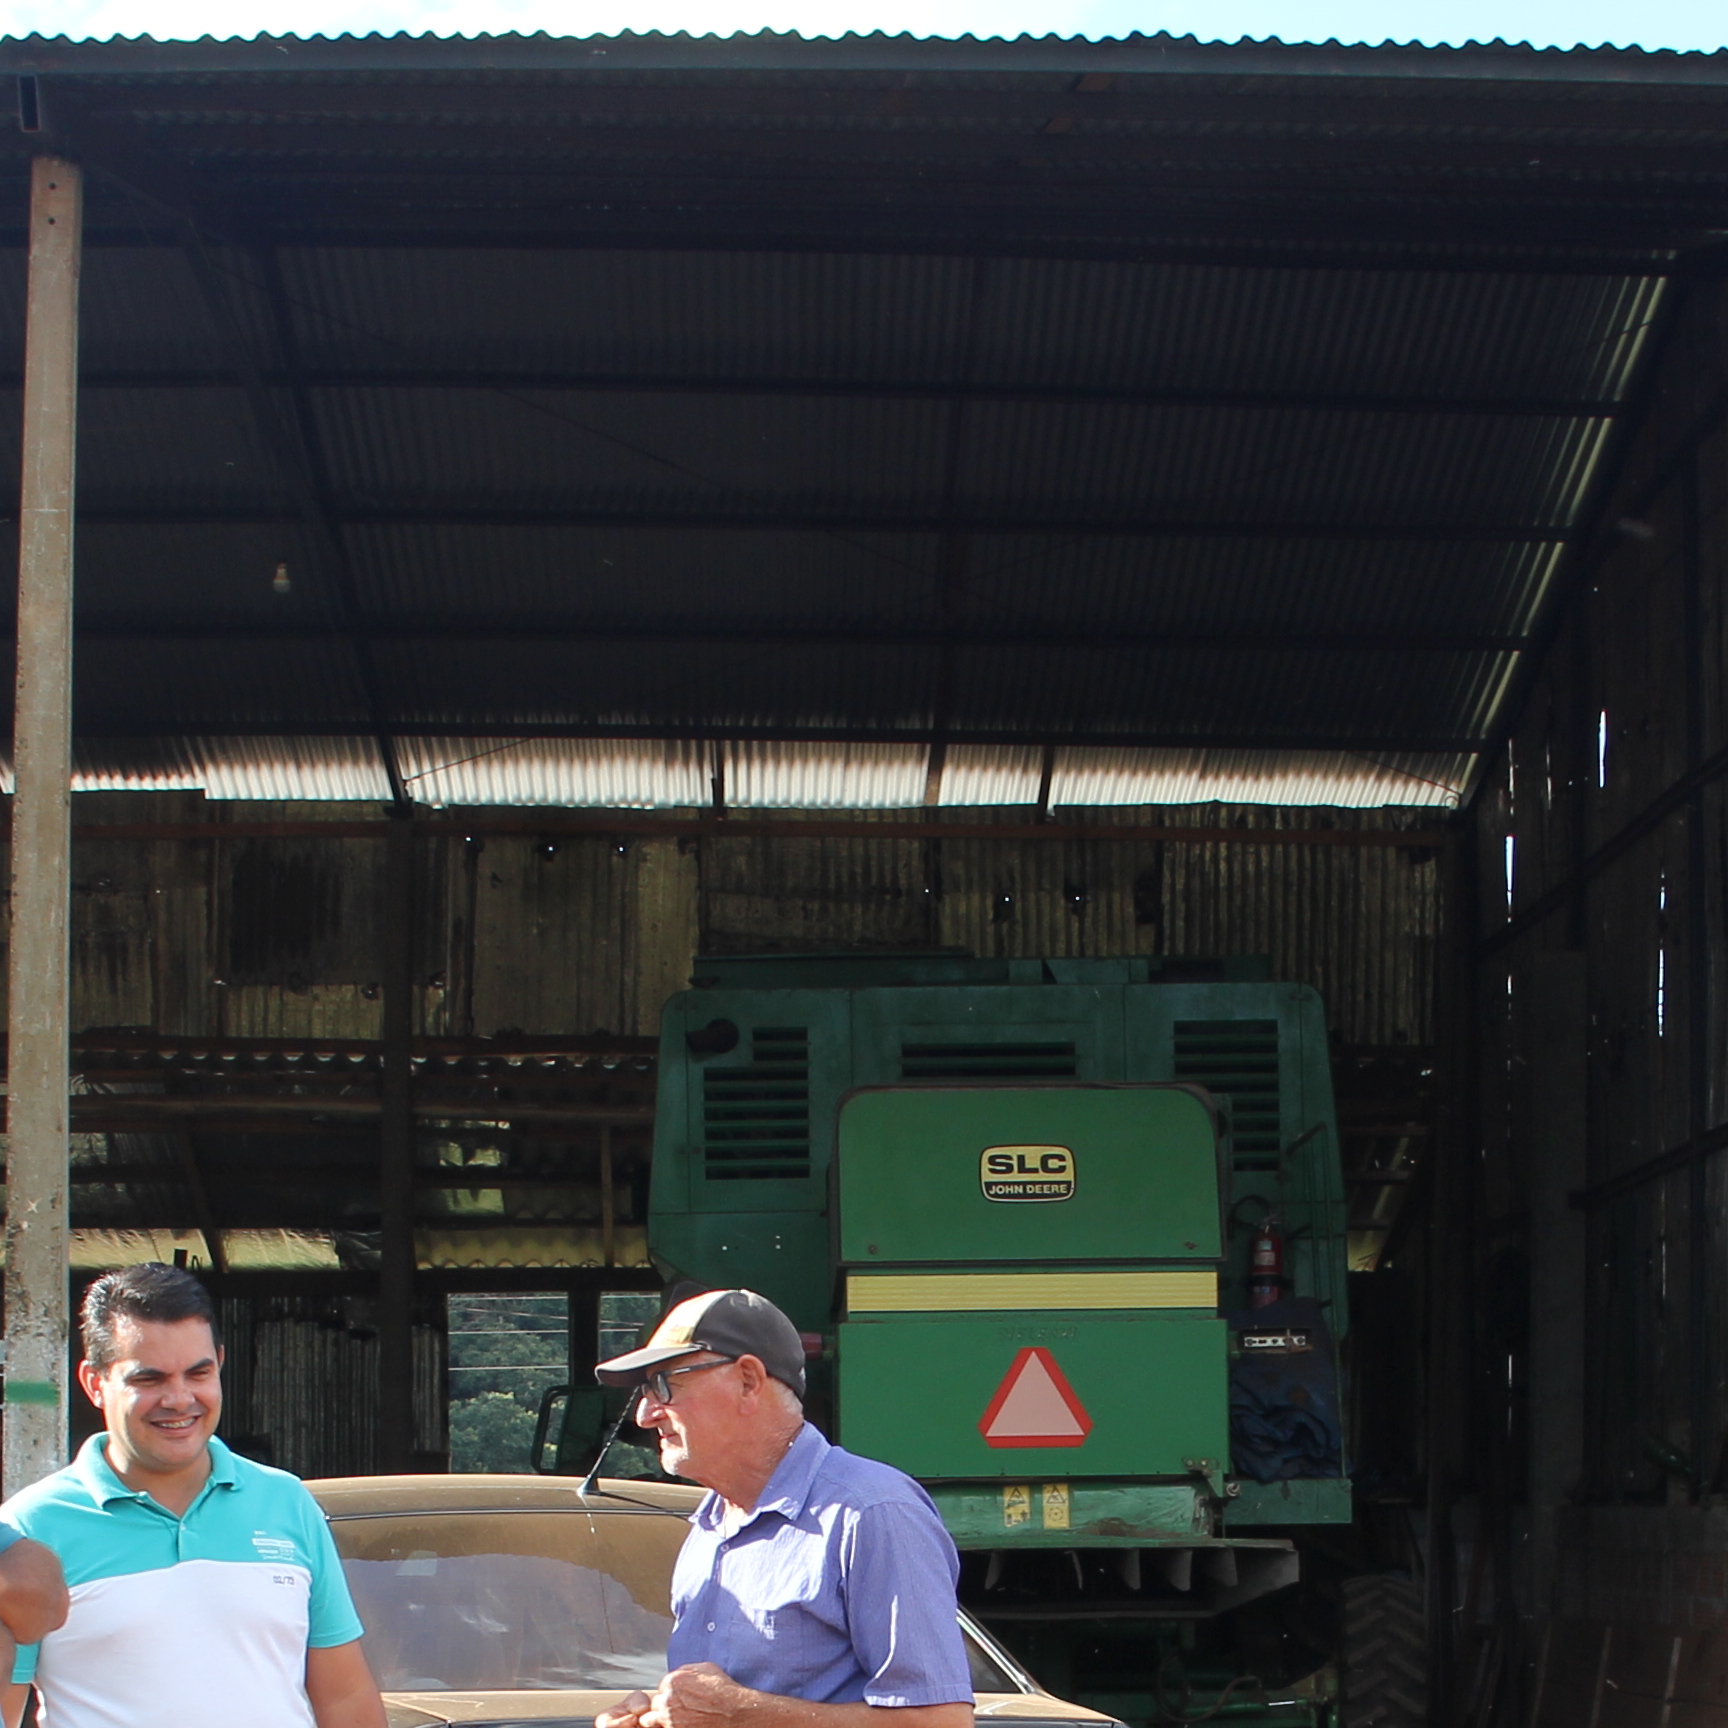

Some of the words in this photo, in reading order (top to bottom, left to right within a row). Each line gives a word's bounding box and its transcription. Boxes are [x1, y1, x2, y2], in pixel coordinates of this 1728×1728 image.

[987, 1153, 1068, 1175] SLC
[988, 1184, 1024, 1195] JOHN
[1026, 1184, 1068, 1194] DEERE
